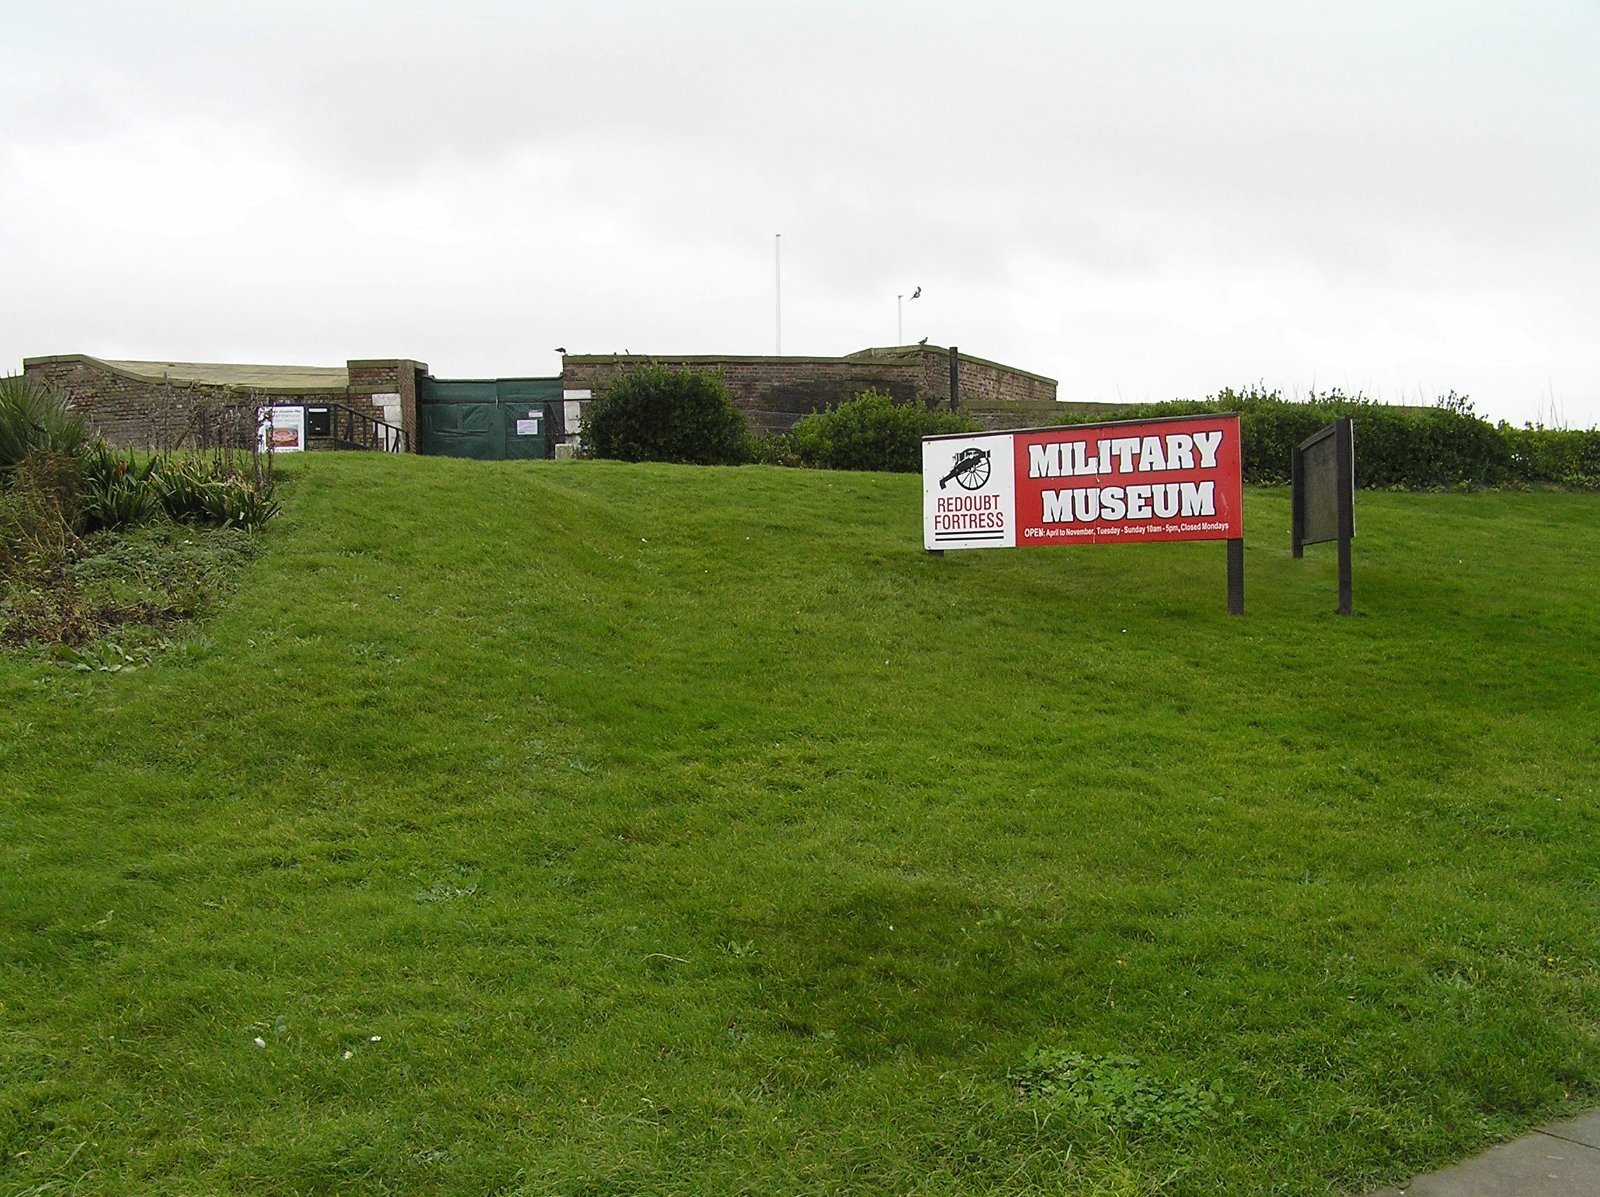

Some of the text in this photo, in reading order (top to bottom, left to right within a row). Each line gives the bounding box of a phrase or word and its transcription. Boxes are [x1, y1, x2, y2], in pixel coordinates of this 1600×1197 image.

[1028, 431, 1223, 478] MILITARY
[938, 494, 1000, 512] REDOUBT
[1041, 480, 1217, 523] MUSEUM
[934, 512, 1004, 530] FORTRESS
[1024, 528, 1046, 538] OPEN:
[1046, 528, 1059, 538] April
[1059, 529, 1066, 537] to
[1096, 526, 1121, 536] Tuesday
[1123, 525, 1146, 535] Sunday
[1146, 524, 1162, 533] 10am
[1180, 522, 1201, 531] Closed
[1201, 521, 1229, 531] Mondays
